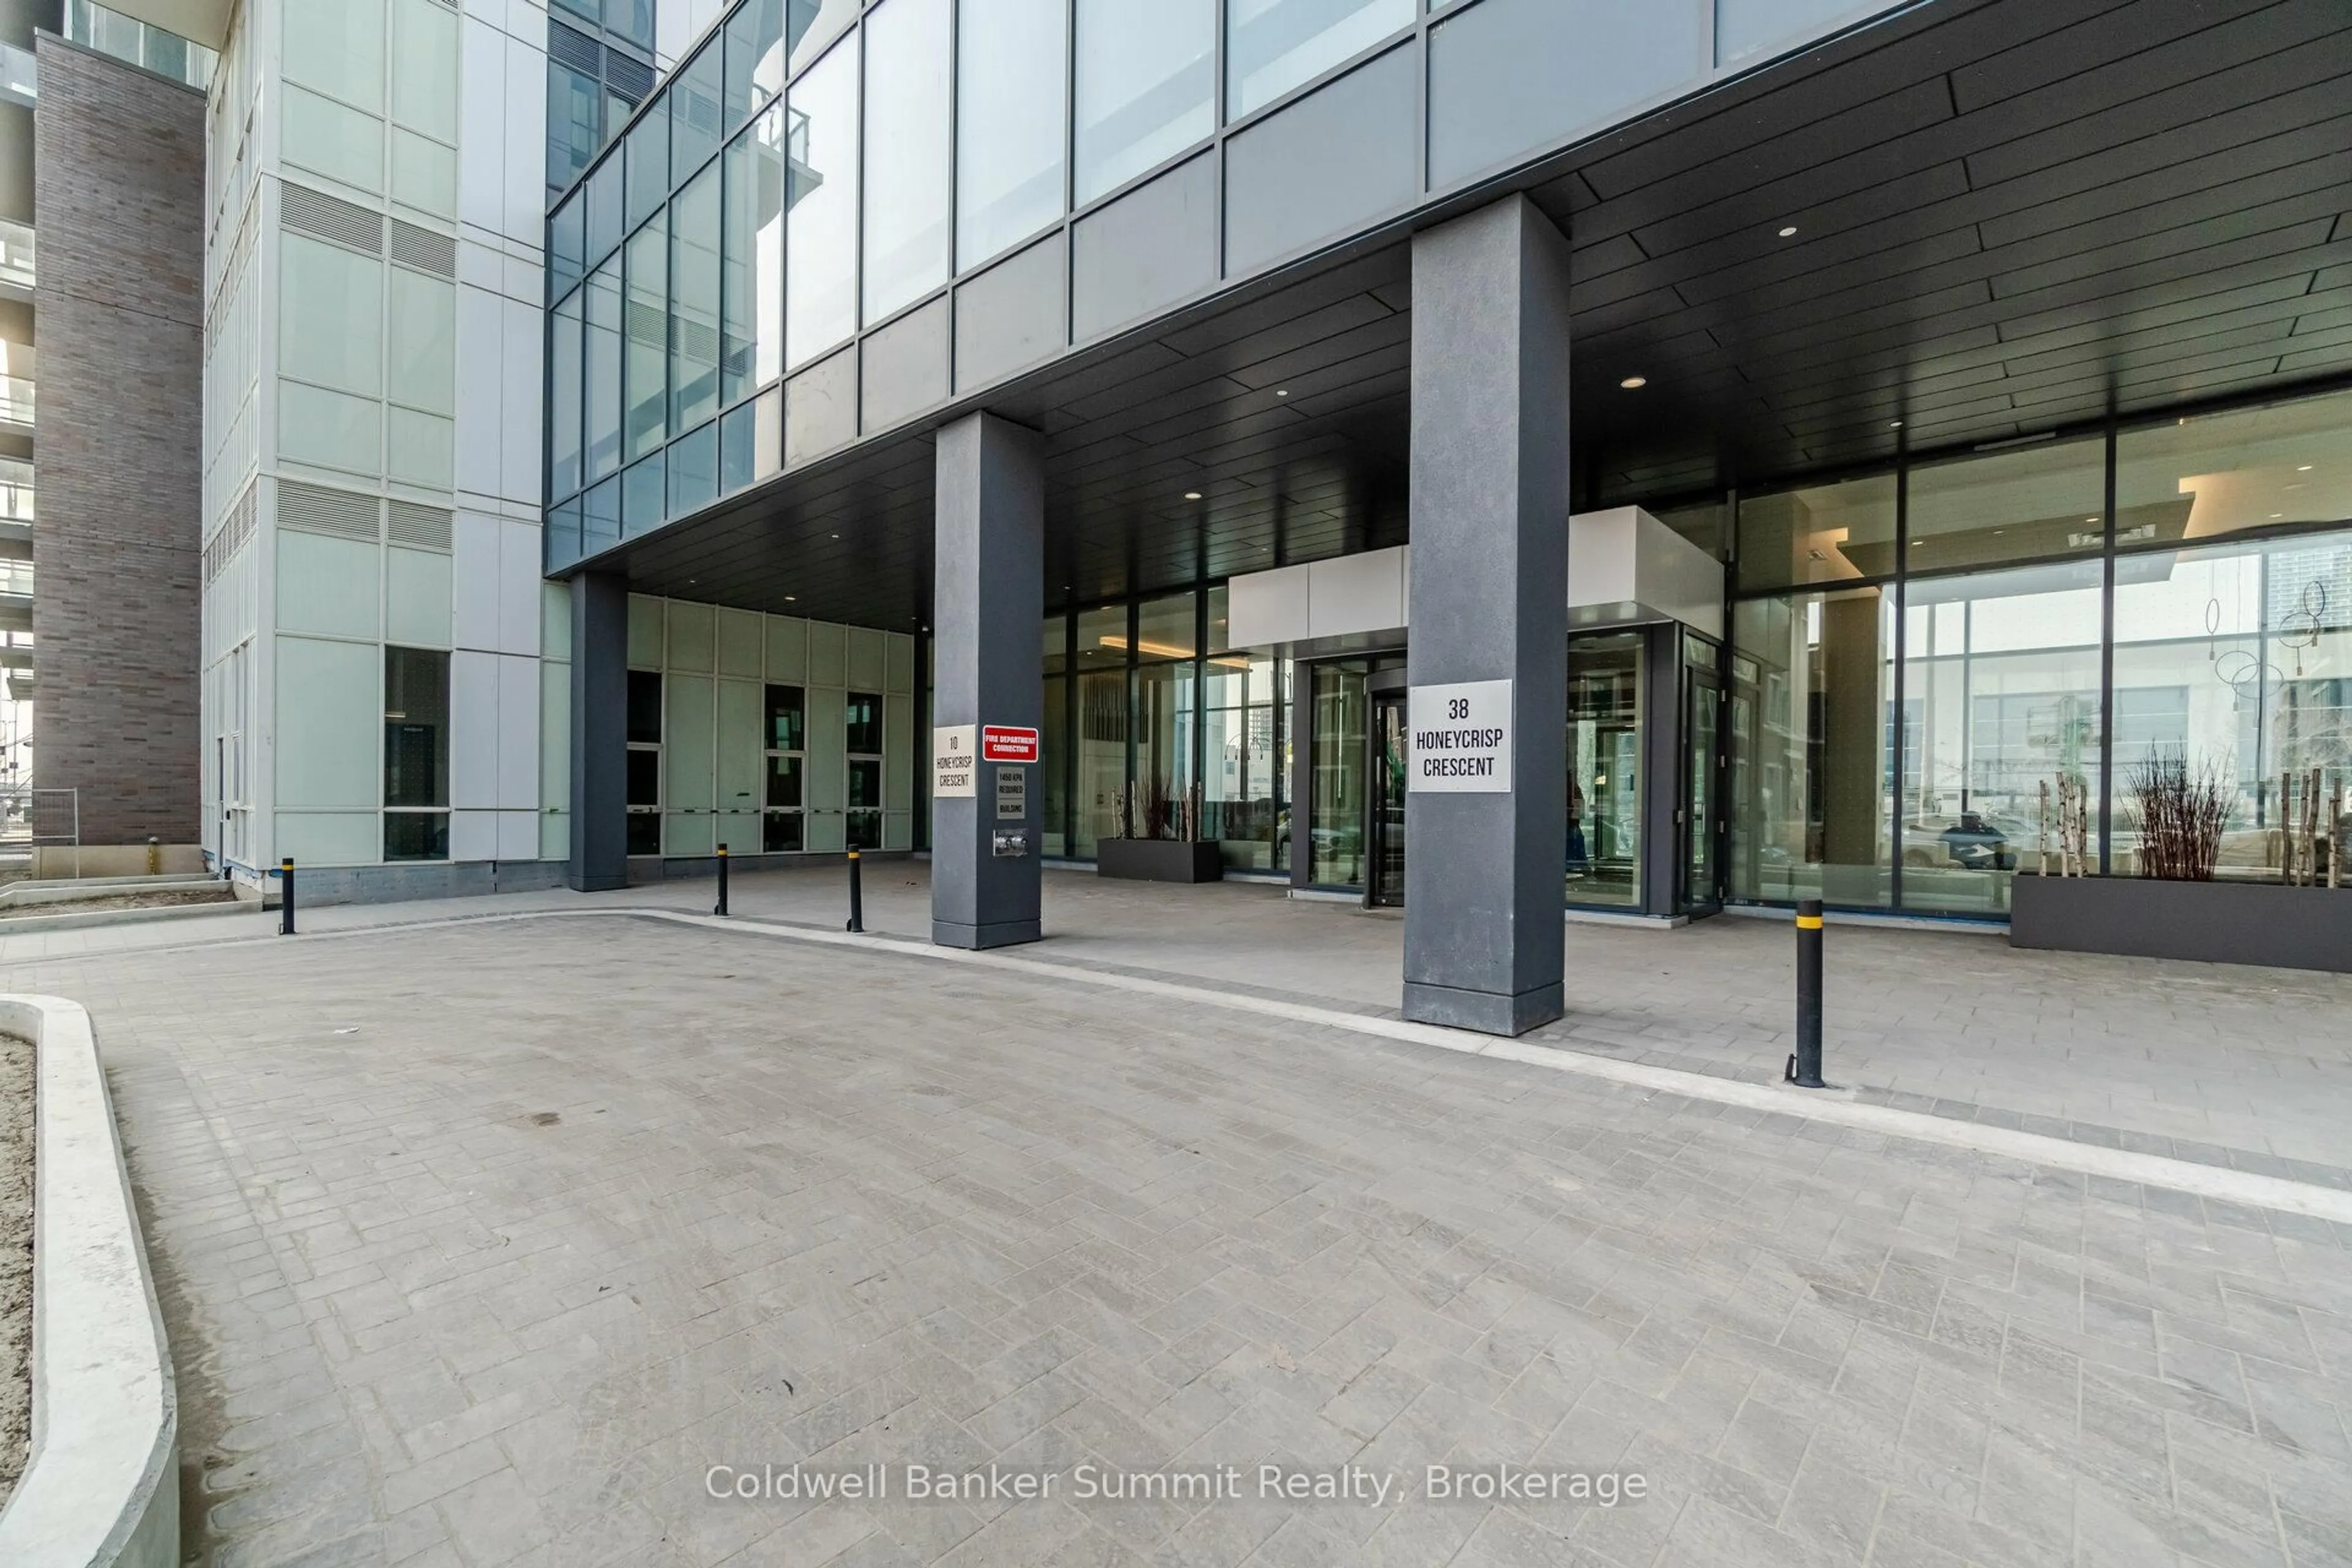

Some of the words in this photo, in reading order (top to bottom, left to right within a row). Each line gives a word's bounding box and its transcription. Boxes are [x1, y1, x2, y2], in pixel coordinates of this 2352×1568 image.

[1449, 698, 1469, 720] 38
[950, 736, 958, 750] 10
[1000, 736, 1036, 744] DEPARTMENT
[1417, 729, 1502, 749] HONEYCRISP
[993, 744, 1029, 753] CONNECTION
[937, 756, 972, 769] HONEYCRISP
[1423, 757, 1494, 776] CRESCENT
[940, 774, 968, 786] CRESCENT
